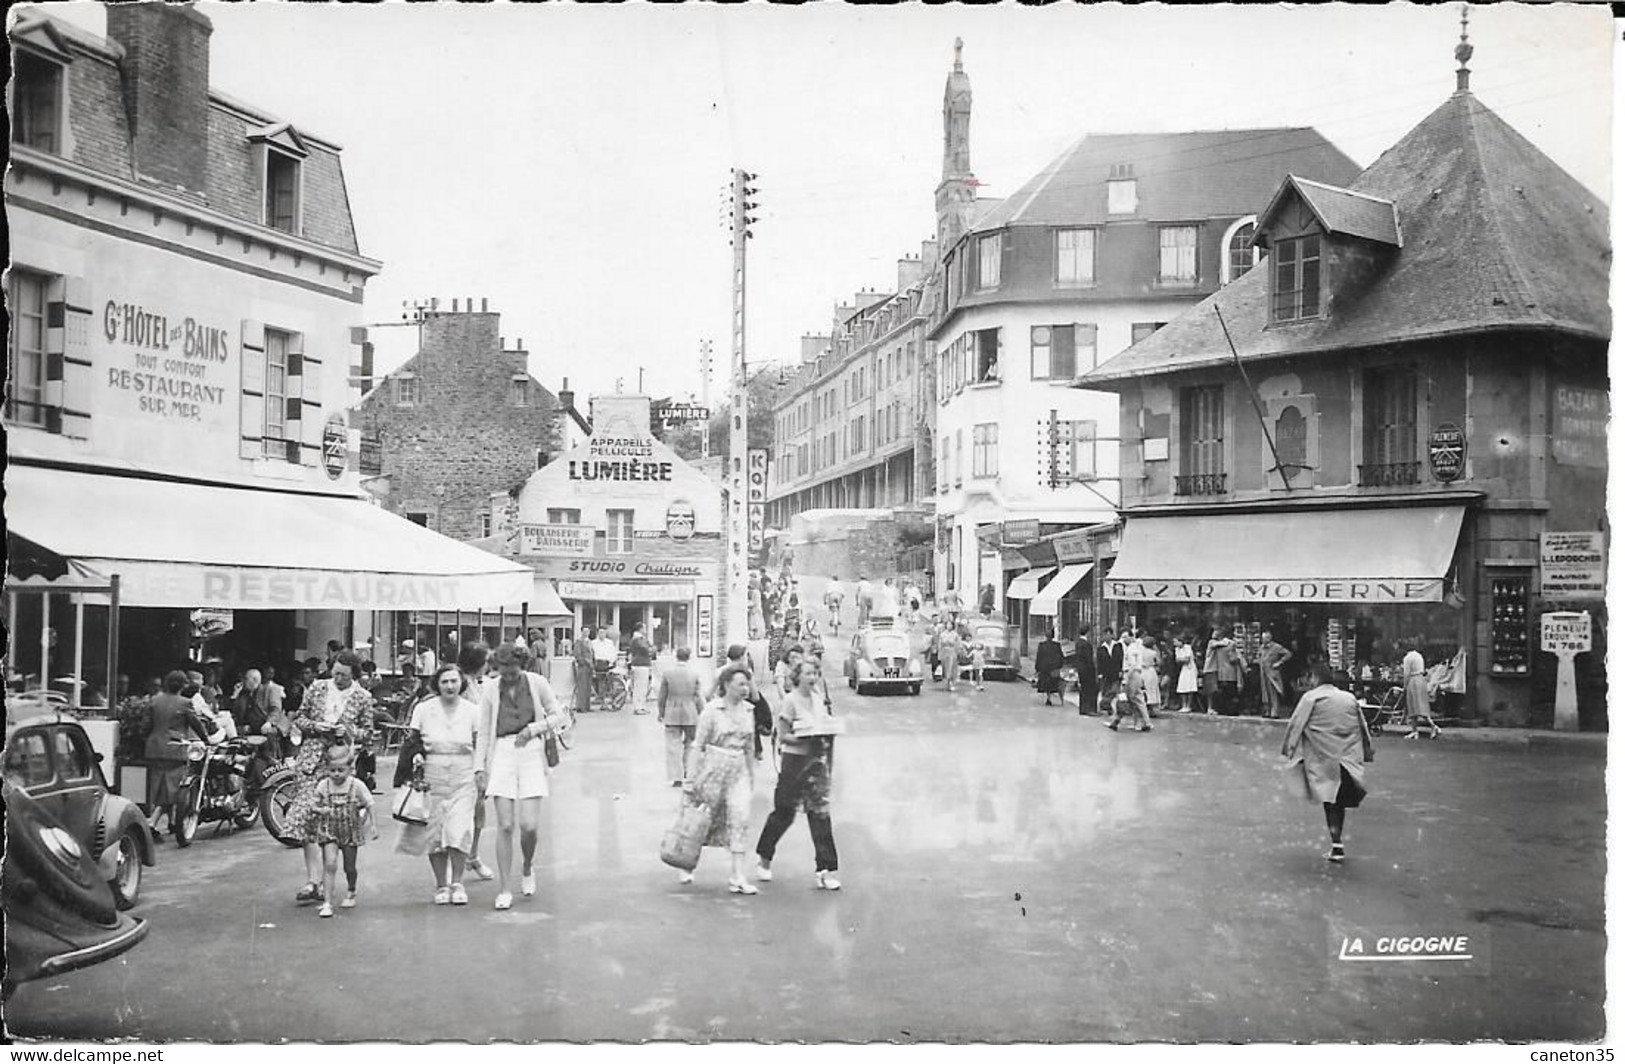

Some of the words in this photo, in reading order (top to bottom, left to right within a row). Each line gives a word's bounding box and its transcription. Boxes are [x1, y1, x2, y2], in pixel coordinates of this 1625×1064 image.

[123, 303, 169, 351] HÔTEL
[184, 316, 228, 363] BAINS
[136, 353, 158, 370] TOUT
[164, 358, 207, 378] CONFORT
[108, 366, 225, 404] RESTAURANT
[139, 395, 168, 417] SUR
[172, 401, 202, 422] MER
[590, 437, 653, 448] APPAREILS
[590, 447, 653, 457] PELLICULES
[568, 458, 673, 482] LUMIÈRE
[524, 526, 580, 538] BOULANGERIE
[536, 536, 589, 548] PATISSERIE
[203, 571, 460, 604] RESTAURANT
[1113, 582, 1215, 599] BAZAR
[1243, 582, 1426, 599] MODERNE
[1544, 624, 1587, 633] PLENEUF
